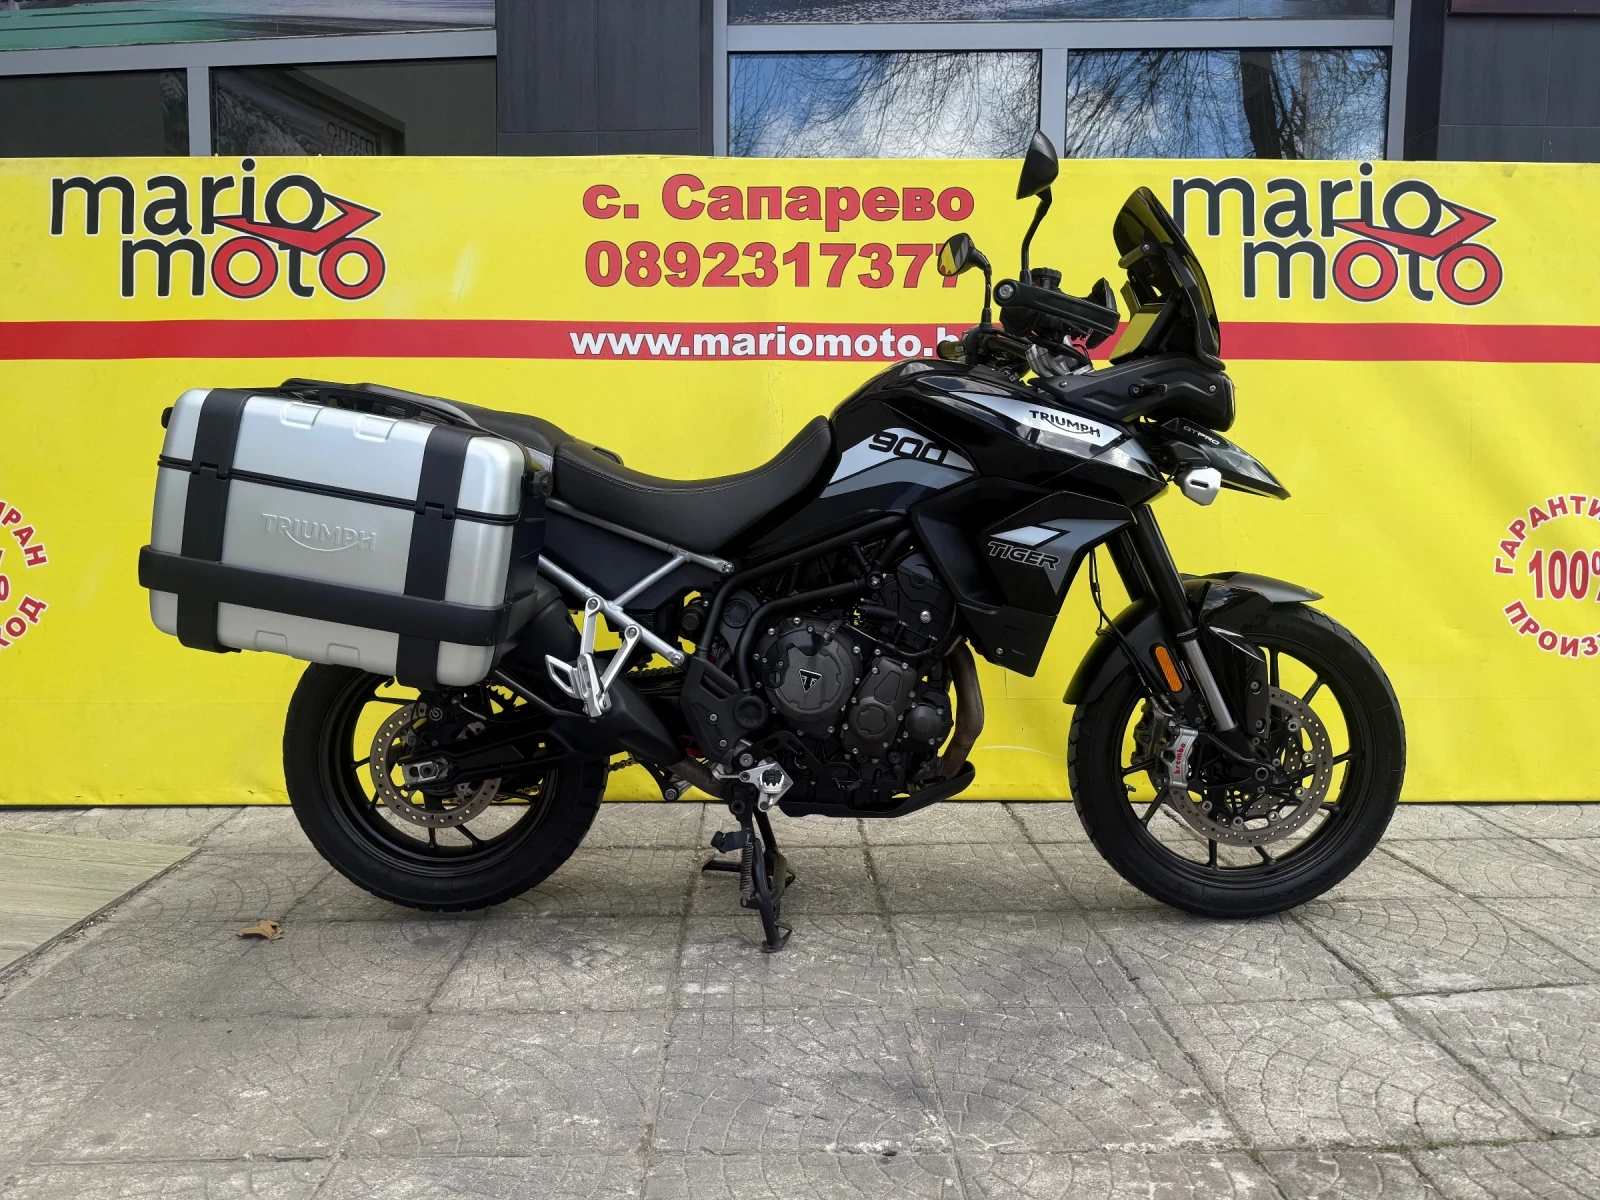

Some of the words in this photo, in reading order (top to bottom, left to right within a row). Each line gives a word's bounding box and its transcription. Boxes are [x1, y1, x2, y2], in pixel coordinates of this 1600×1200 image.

[50, 157, 327, 236] mario
[582, 184, 639, 219] с.
[661, 173, 975, 232] Сапарево
[1172, 162, 1443, 239] mario
[121, 235, 387, 299] moto
[1242, 238, 1503, 306] moto
[568, 325, 963, 357] www.mariomoto.b
[1029, 409, 1100, 437] TRIUMPH
[868, 430, 949, 464] 900
[261, 513, 377, 551] TRIUMPH
[988, 541, 1060, 570] TIGER
[1174, 742, 1187, 775] brembo
